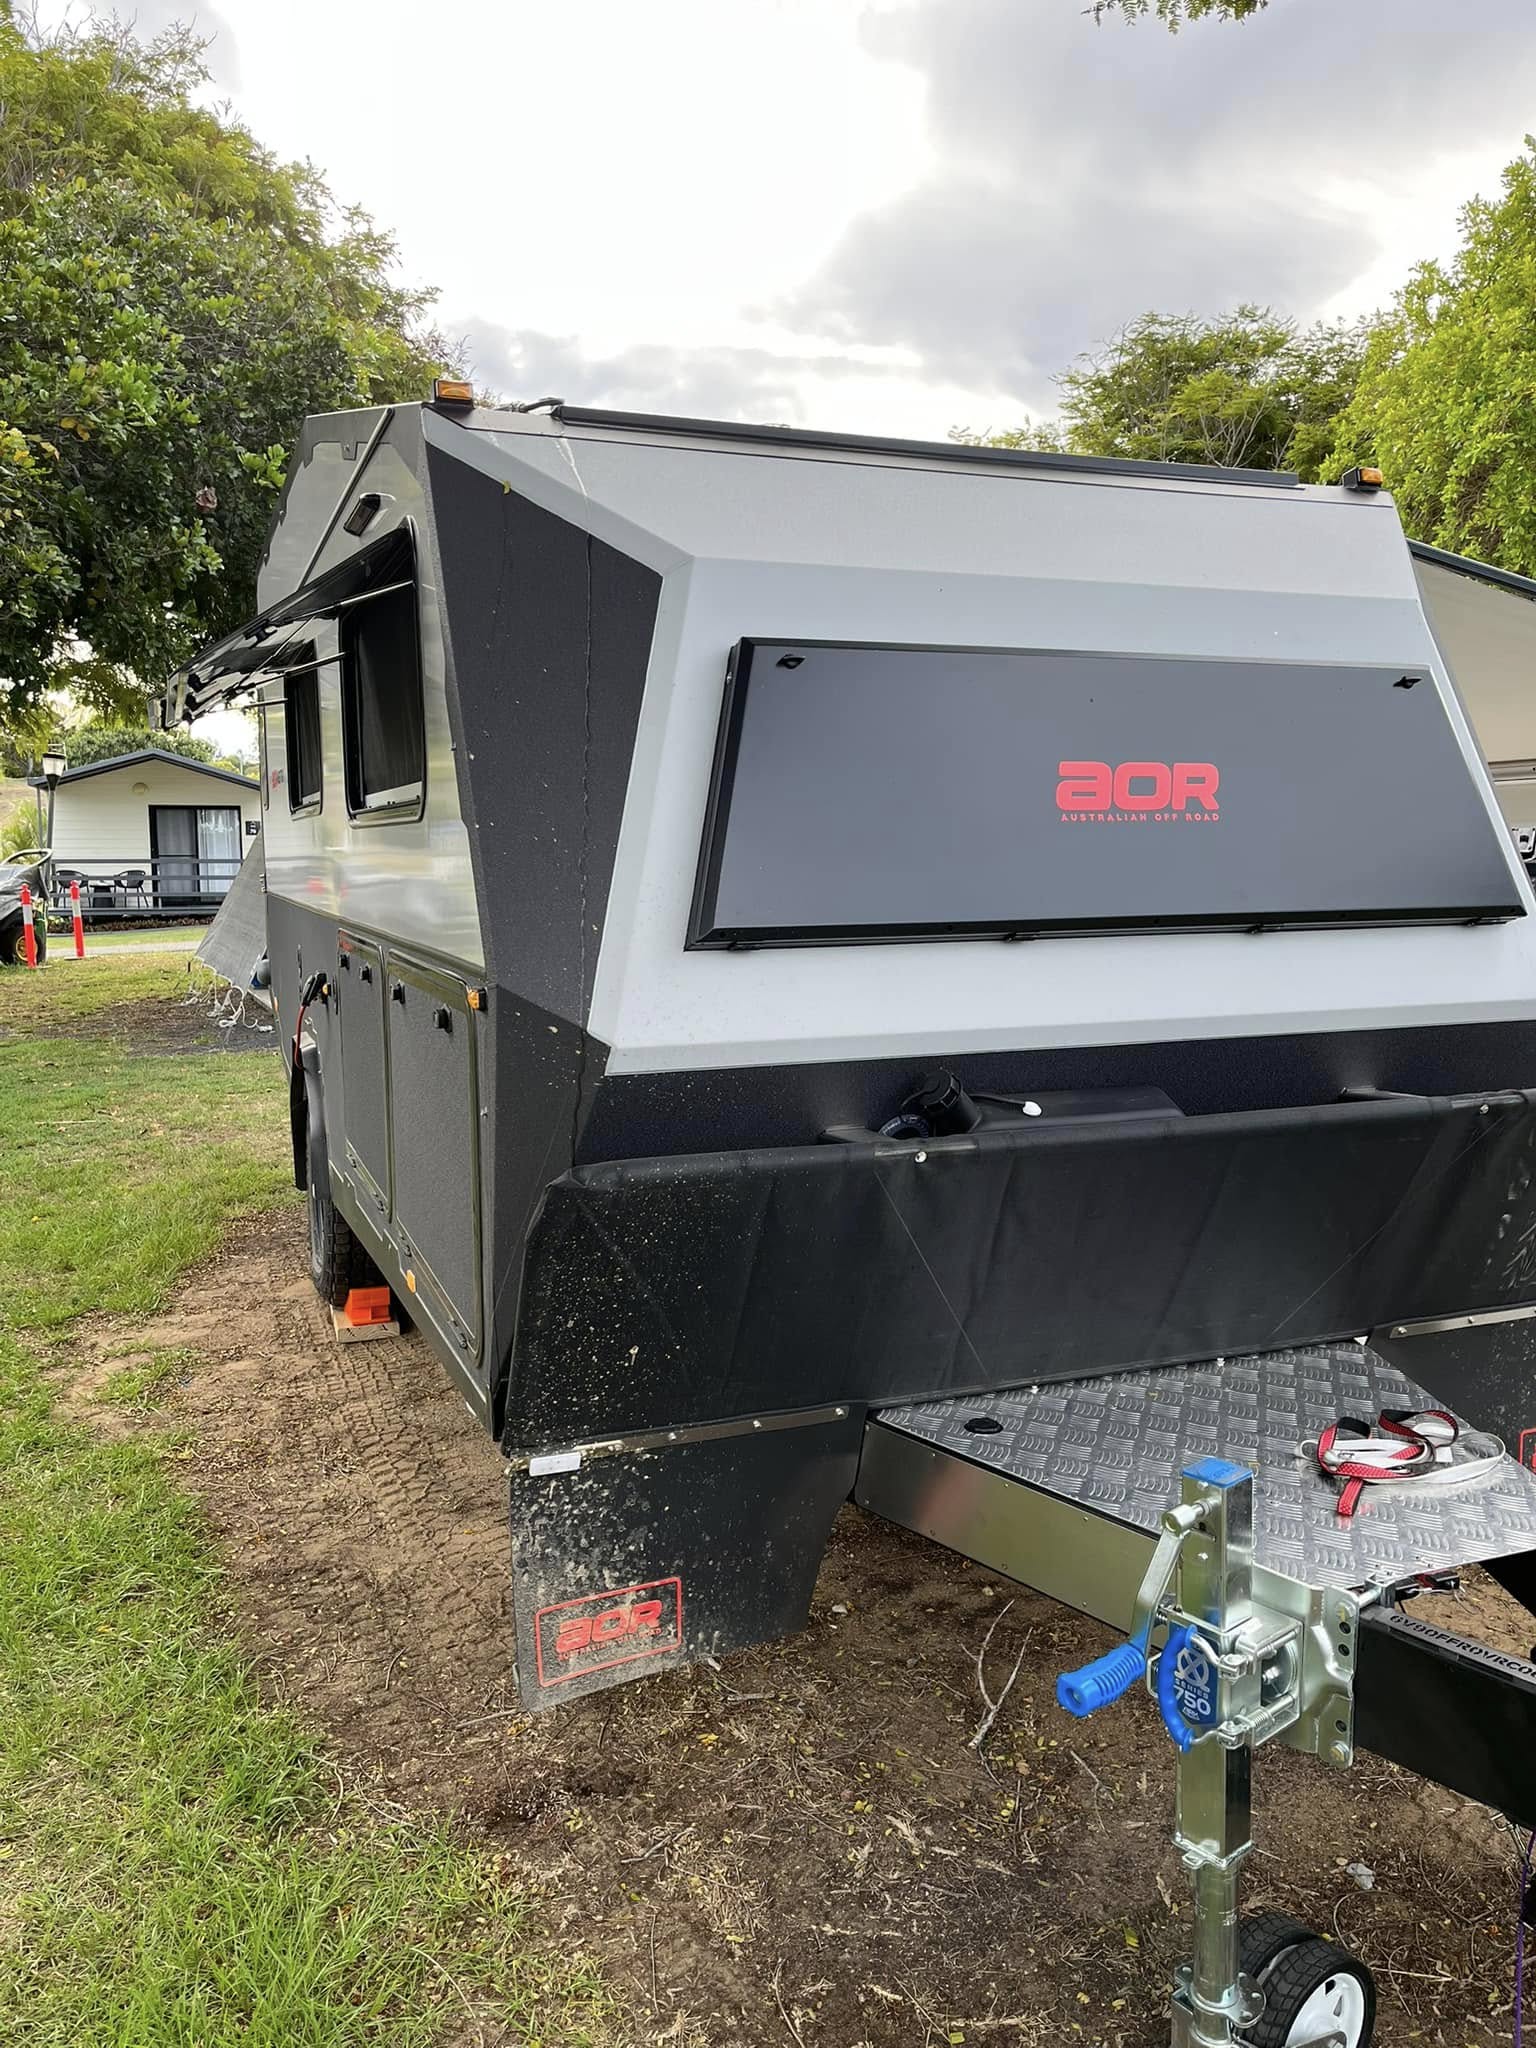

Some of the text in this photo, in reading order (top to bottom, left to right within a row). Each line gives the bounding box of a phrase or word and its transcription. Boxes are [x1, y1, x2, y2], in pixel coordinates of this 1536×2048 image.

[1060, 813, 1220, 822] AUSTRALIAN OFF ROAD
[1173, 1684, 1211, 1716] 750
